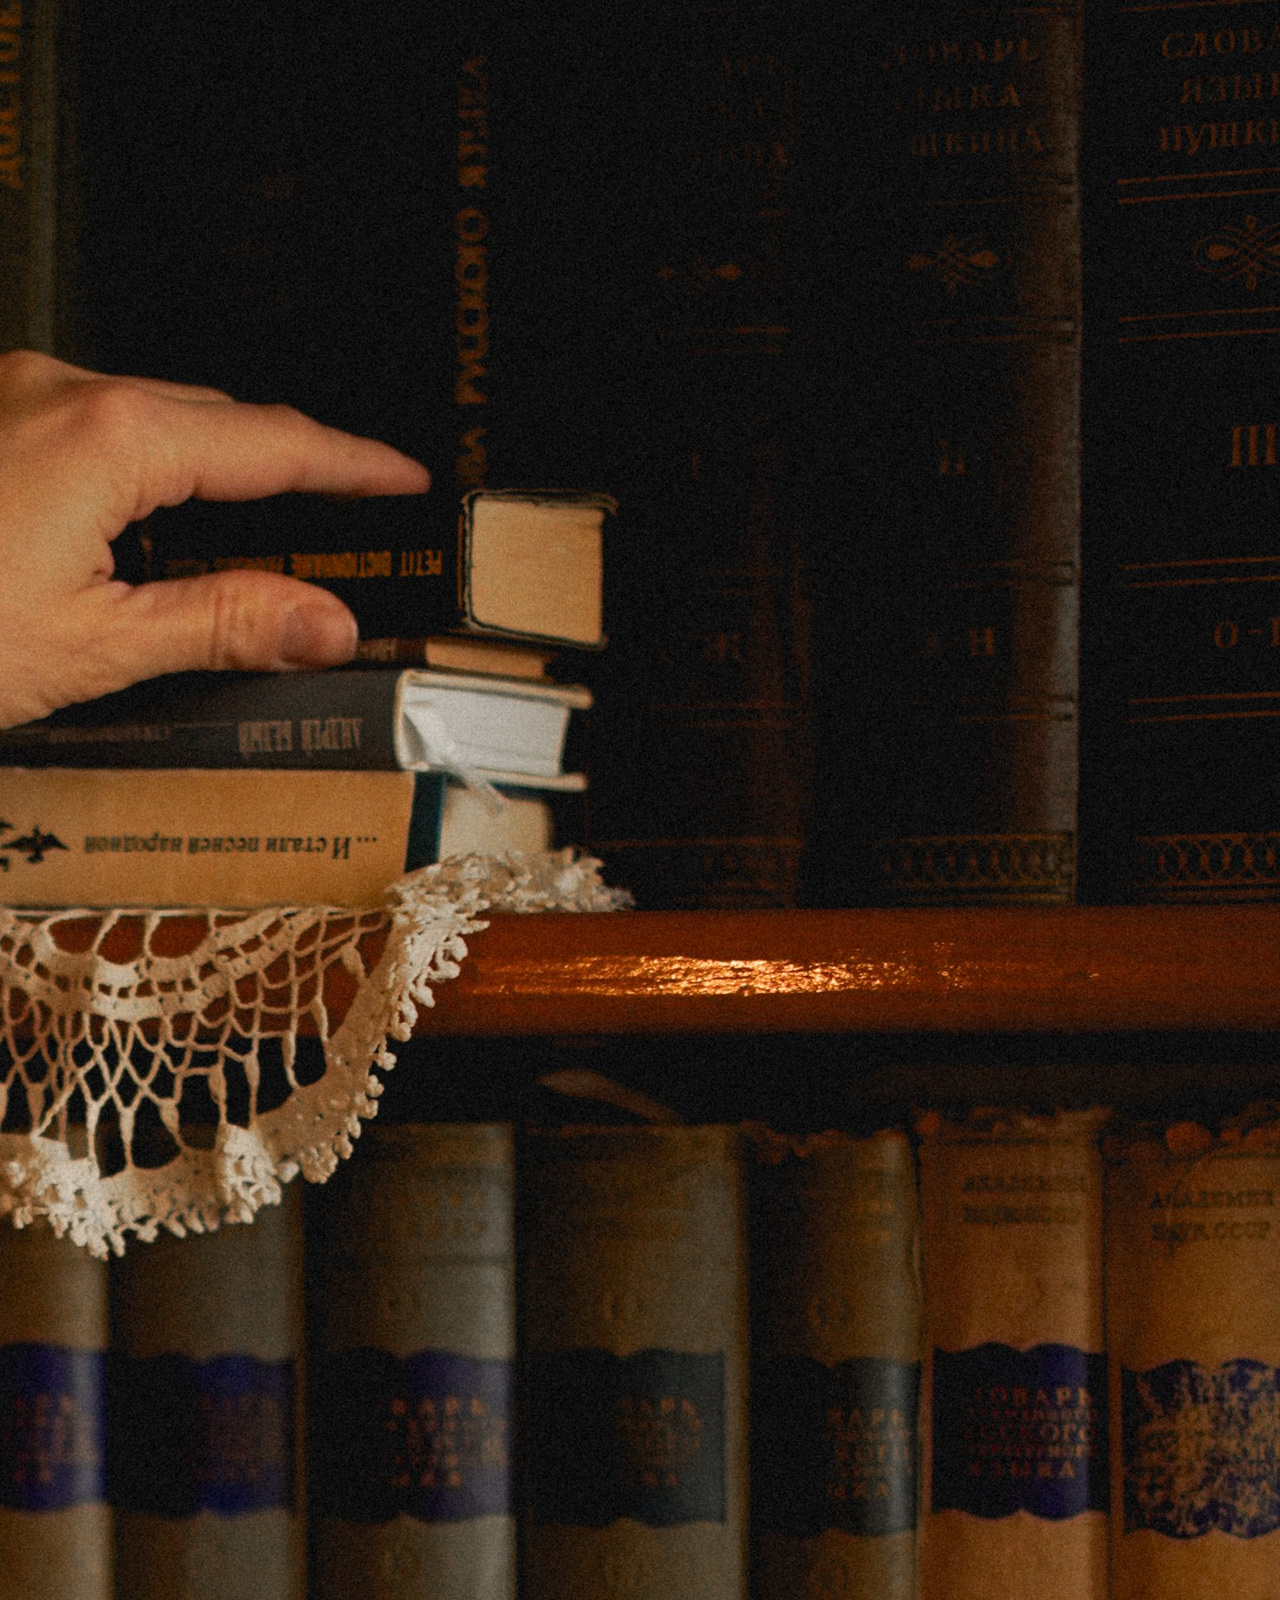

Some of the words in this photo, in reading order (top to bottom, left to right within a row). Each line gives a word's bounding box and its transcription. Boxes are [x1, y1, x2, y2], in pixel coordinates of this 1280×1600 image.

[399, 549, 444, 577] PETIT
[83, 832, 183, 856] народной
[187, 837, 260, 857] песней
[265, 837, 327, 855] стали
[969, 1383, 1095, 1407] ЛОВАРЬ
